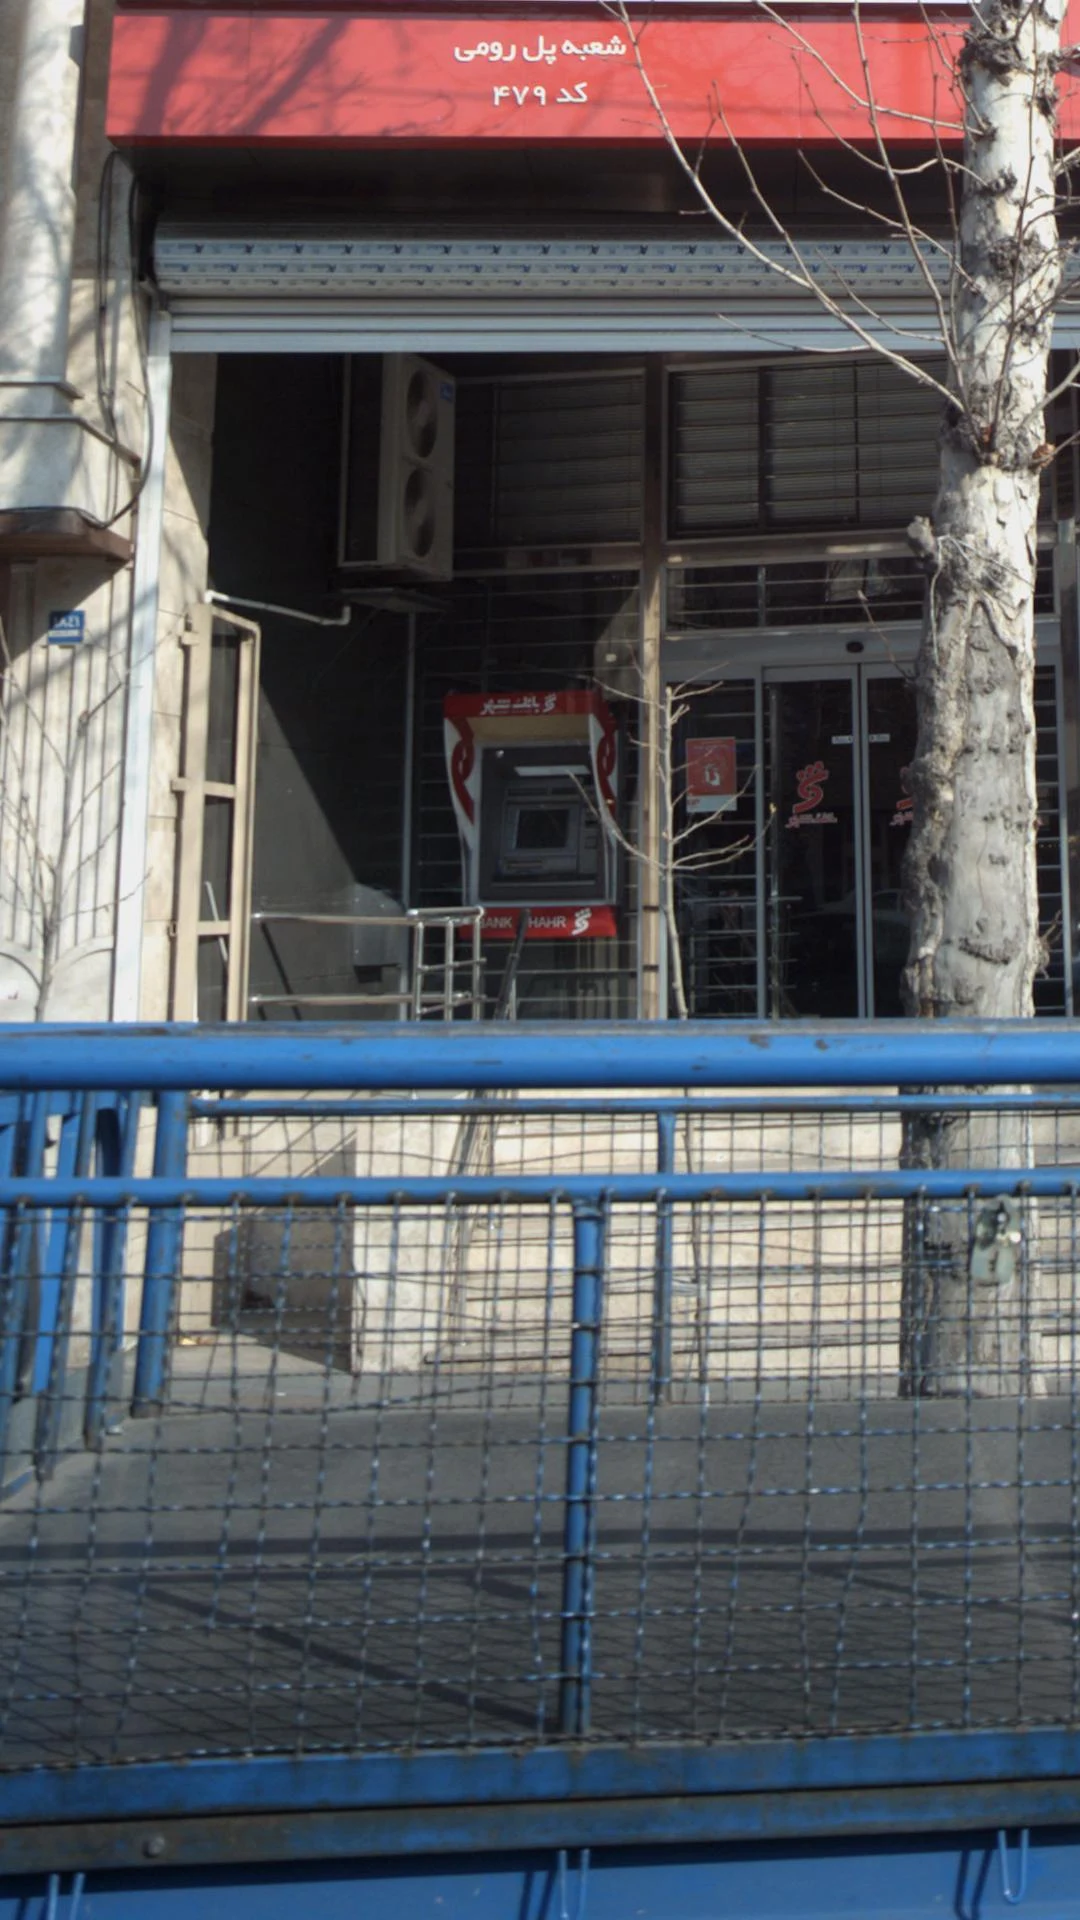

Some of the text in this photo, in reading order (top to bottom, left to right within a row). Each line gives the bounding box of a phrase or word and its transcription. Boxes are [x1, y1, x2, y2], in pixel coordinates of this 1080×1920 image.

[453, 34, 627, 65] شعبه پل رومی
[493, 82, 588, 106] کد ۴۷۹
[526, 915, 567, 929] HAHR
